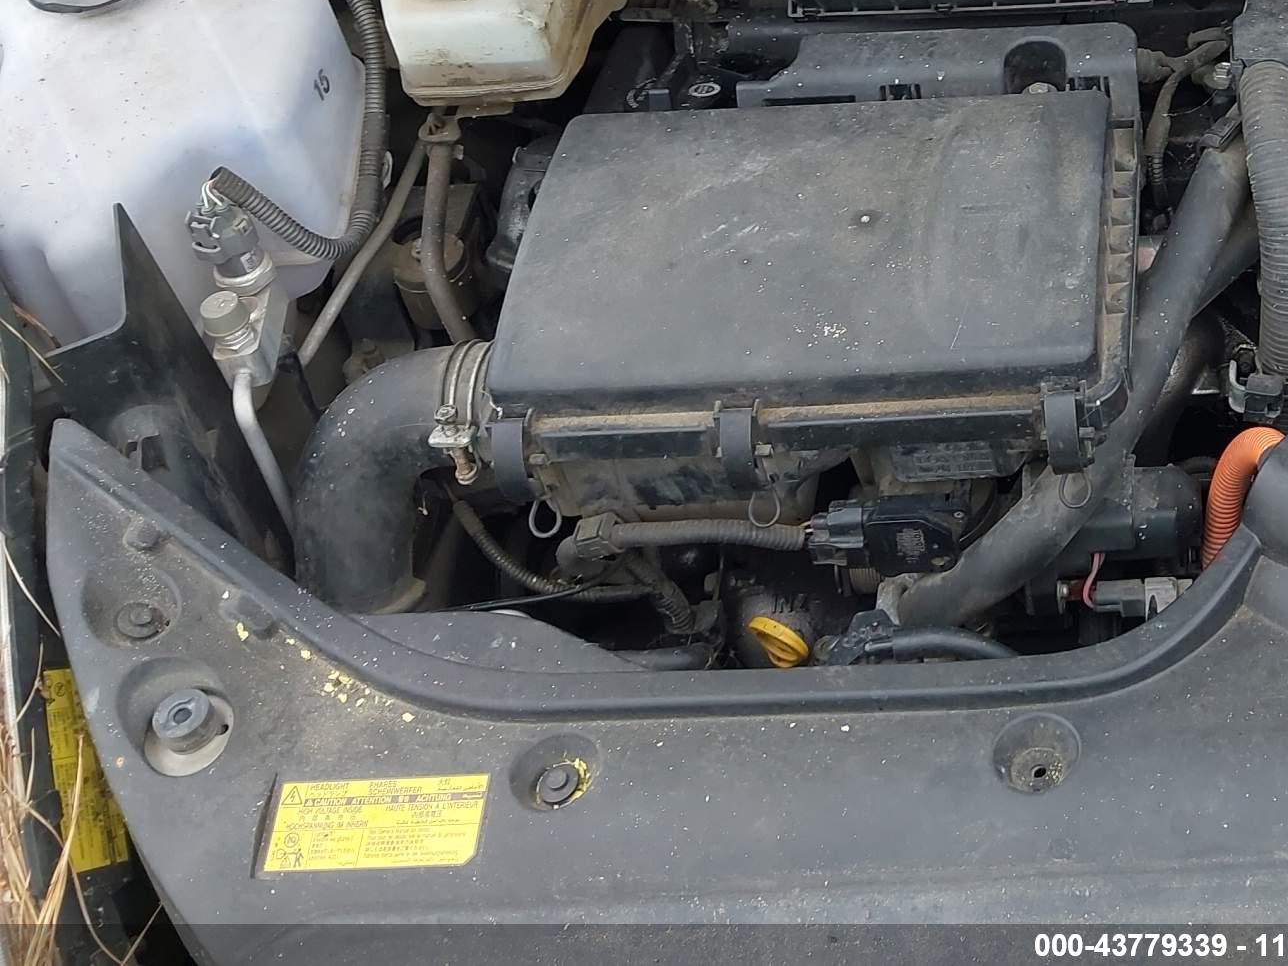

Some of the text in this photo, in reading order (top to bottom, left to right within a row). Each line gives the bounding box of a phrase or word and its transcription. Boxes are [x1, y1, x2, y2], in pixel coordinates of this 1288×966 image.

[310, 782, 350, 791] HEADLIGHT
[313, 797, 347, 807] CAUTION
[351, 795, 393, 805] ATTENTION
[416, 793, 452, 802] ACHTUNG
